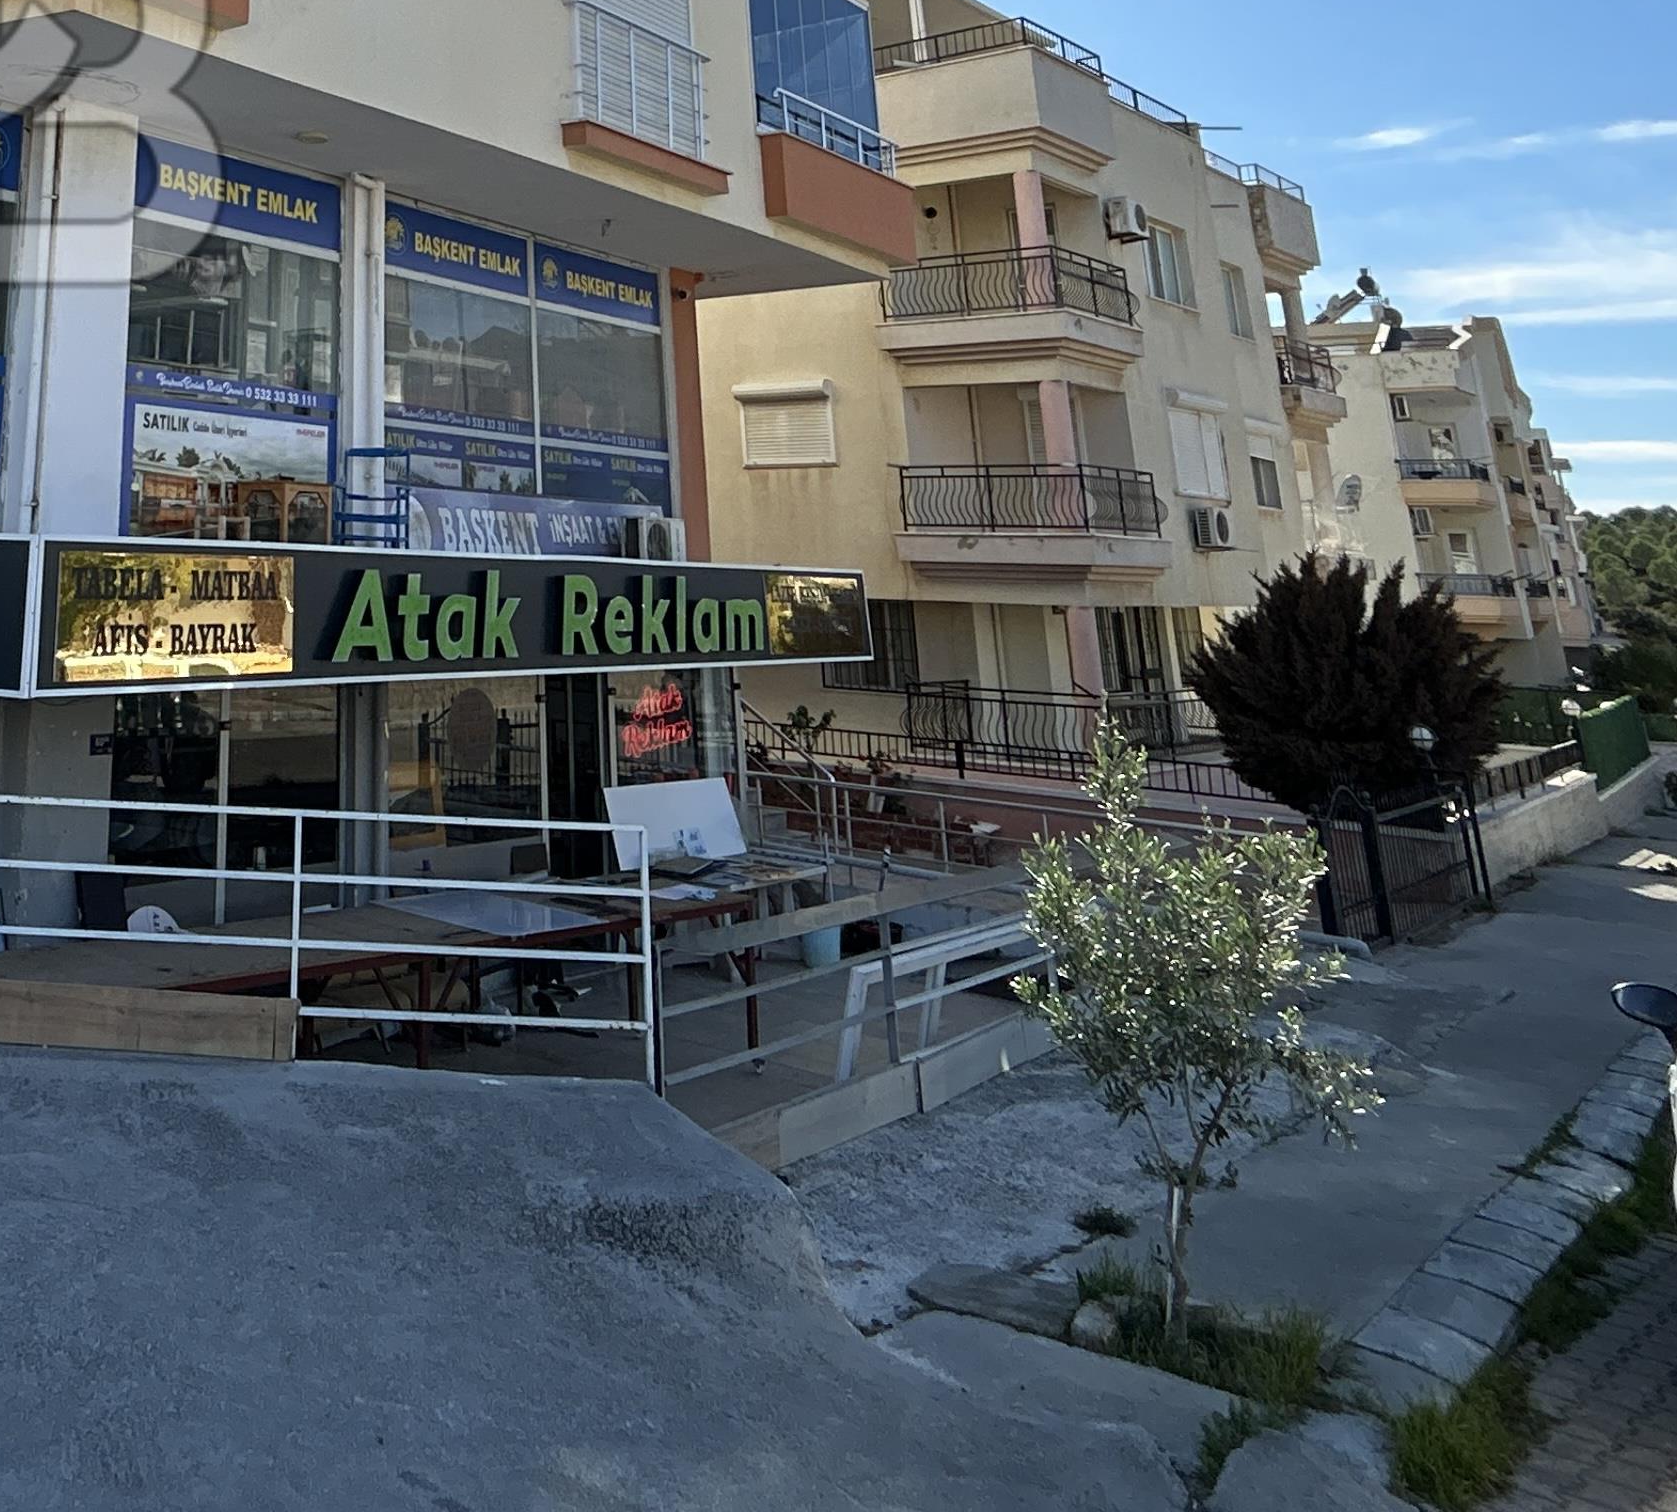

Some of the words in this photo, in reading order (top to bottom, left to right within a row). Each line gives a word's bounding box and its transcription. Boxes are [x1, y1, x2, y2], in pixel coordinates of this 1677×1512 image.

[159, 162, 252, 207] BAŞKENT
[256, 187, 319, 224] EMLAK
[414, 231, 476, 266] BAŞKENT
[478, 250, 521, 278] EMLAK
[566, 270, 616, 299] BAŞKENT
[618, 284, 653, 309] EMLAK
[245, 386, 252, 399] 0
[254, 387, 272, 401] 532
[273, 390, 286, 403] 33
[287, 392, 300, 405] 33
[301, 393, 317, 407] 111
[143, 412, 190, 433] SATILIK
[386, 431, 416, 448] ATILIK
[464, 440, 497, 458] SATILIK
[73, 567, 165, 601] TABELA
[190, 569, 280, 601] MATBAA
[332, 567, 521, 664] Atak
[561, 574, 766, 657] Reklam
[168, 622, 257, 657] BAYRAK
[633, 682, 684, 722] Atak
[621, 718, 693, 759] Reklam
